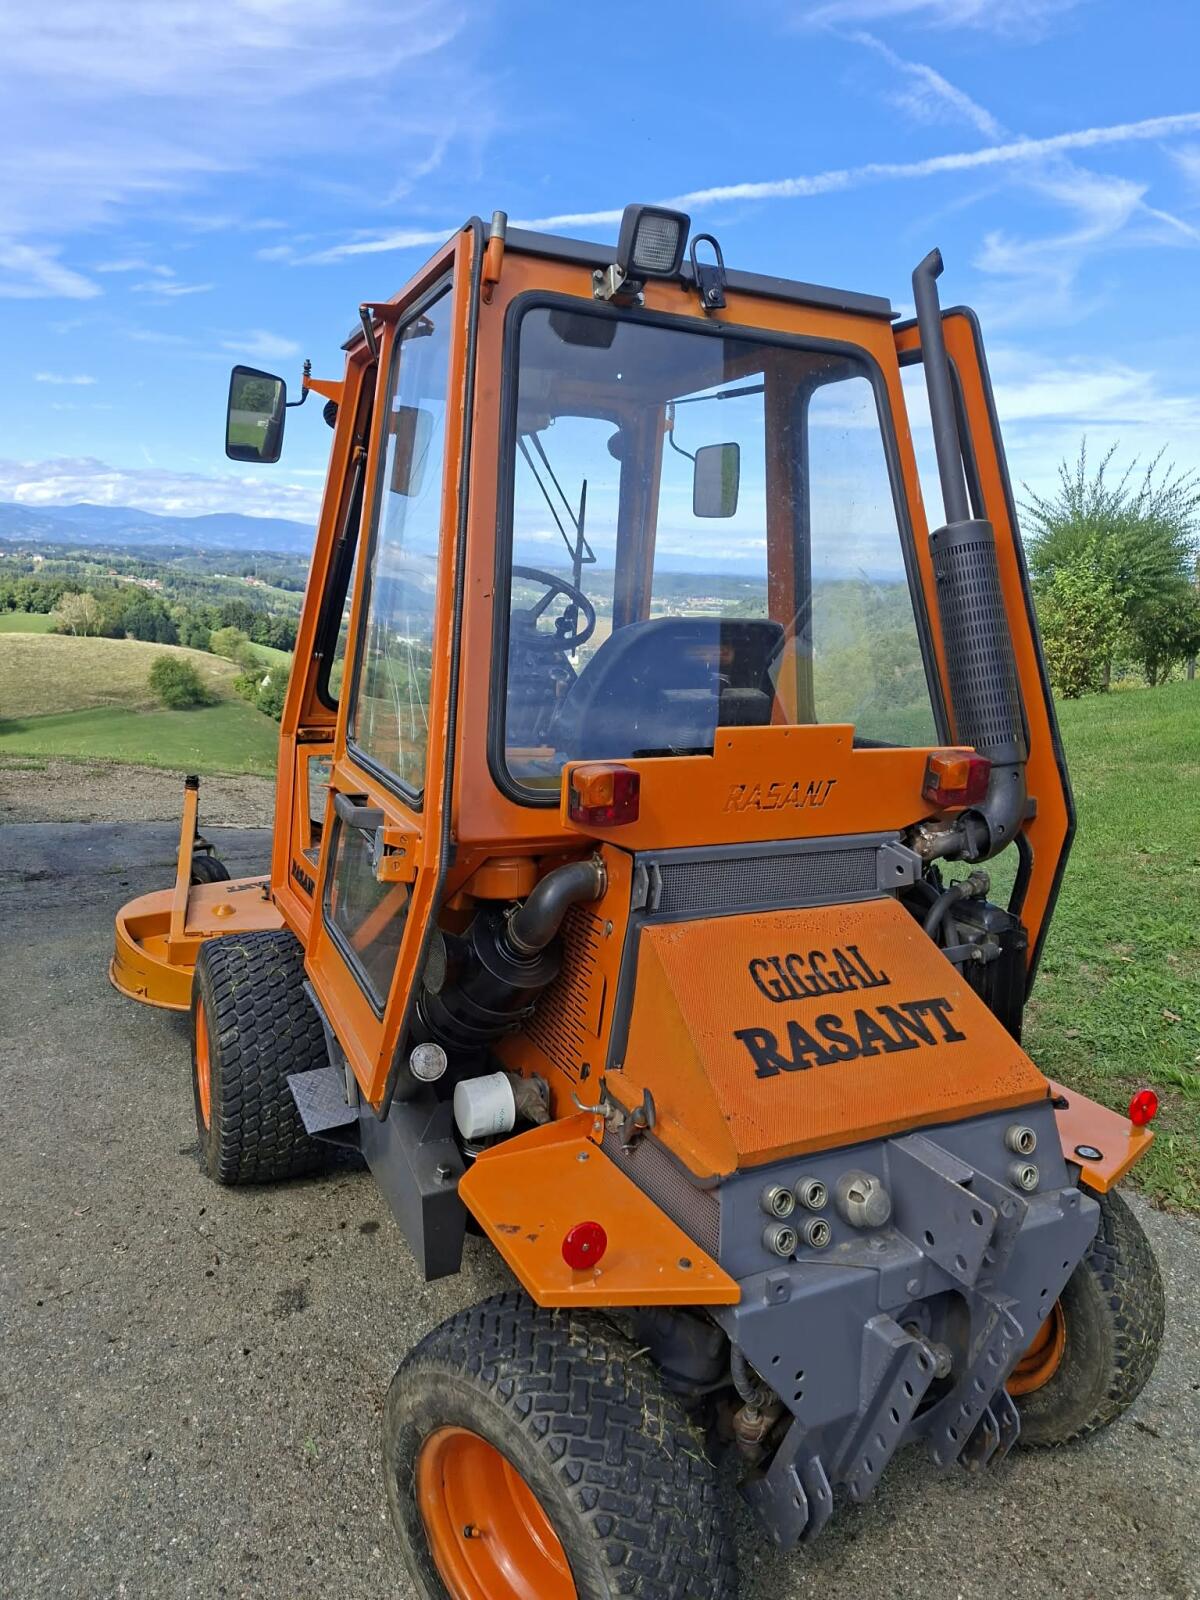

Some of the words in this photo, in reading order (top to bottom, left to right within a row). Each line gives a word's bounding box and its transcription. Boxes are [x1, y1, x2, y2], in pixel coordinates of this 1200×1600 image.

[722, 779, 838, 813] RASANT
[748, 944, 891, 1003] GIGGAL
[733, 997, 967, 1079] RASANT
